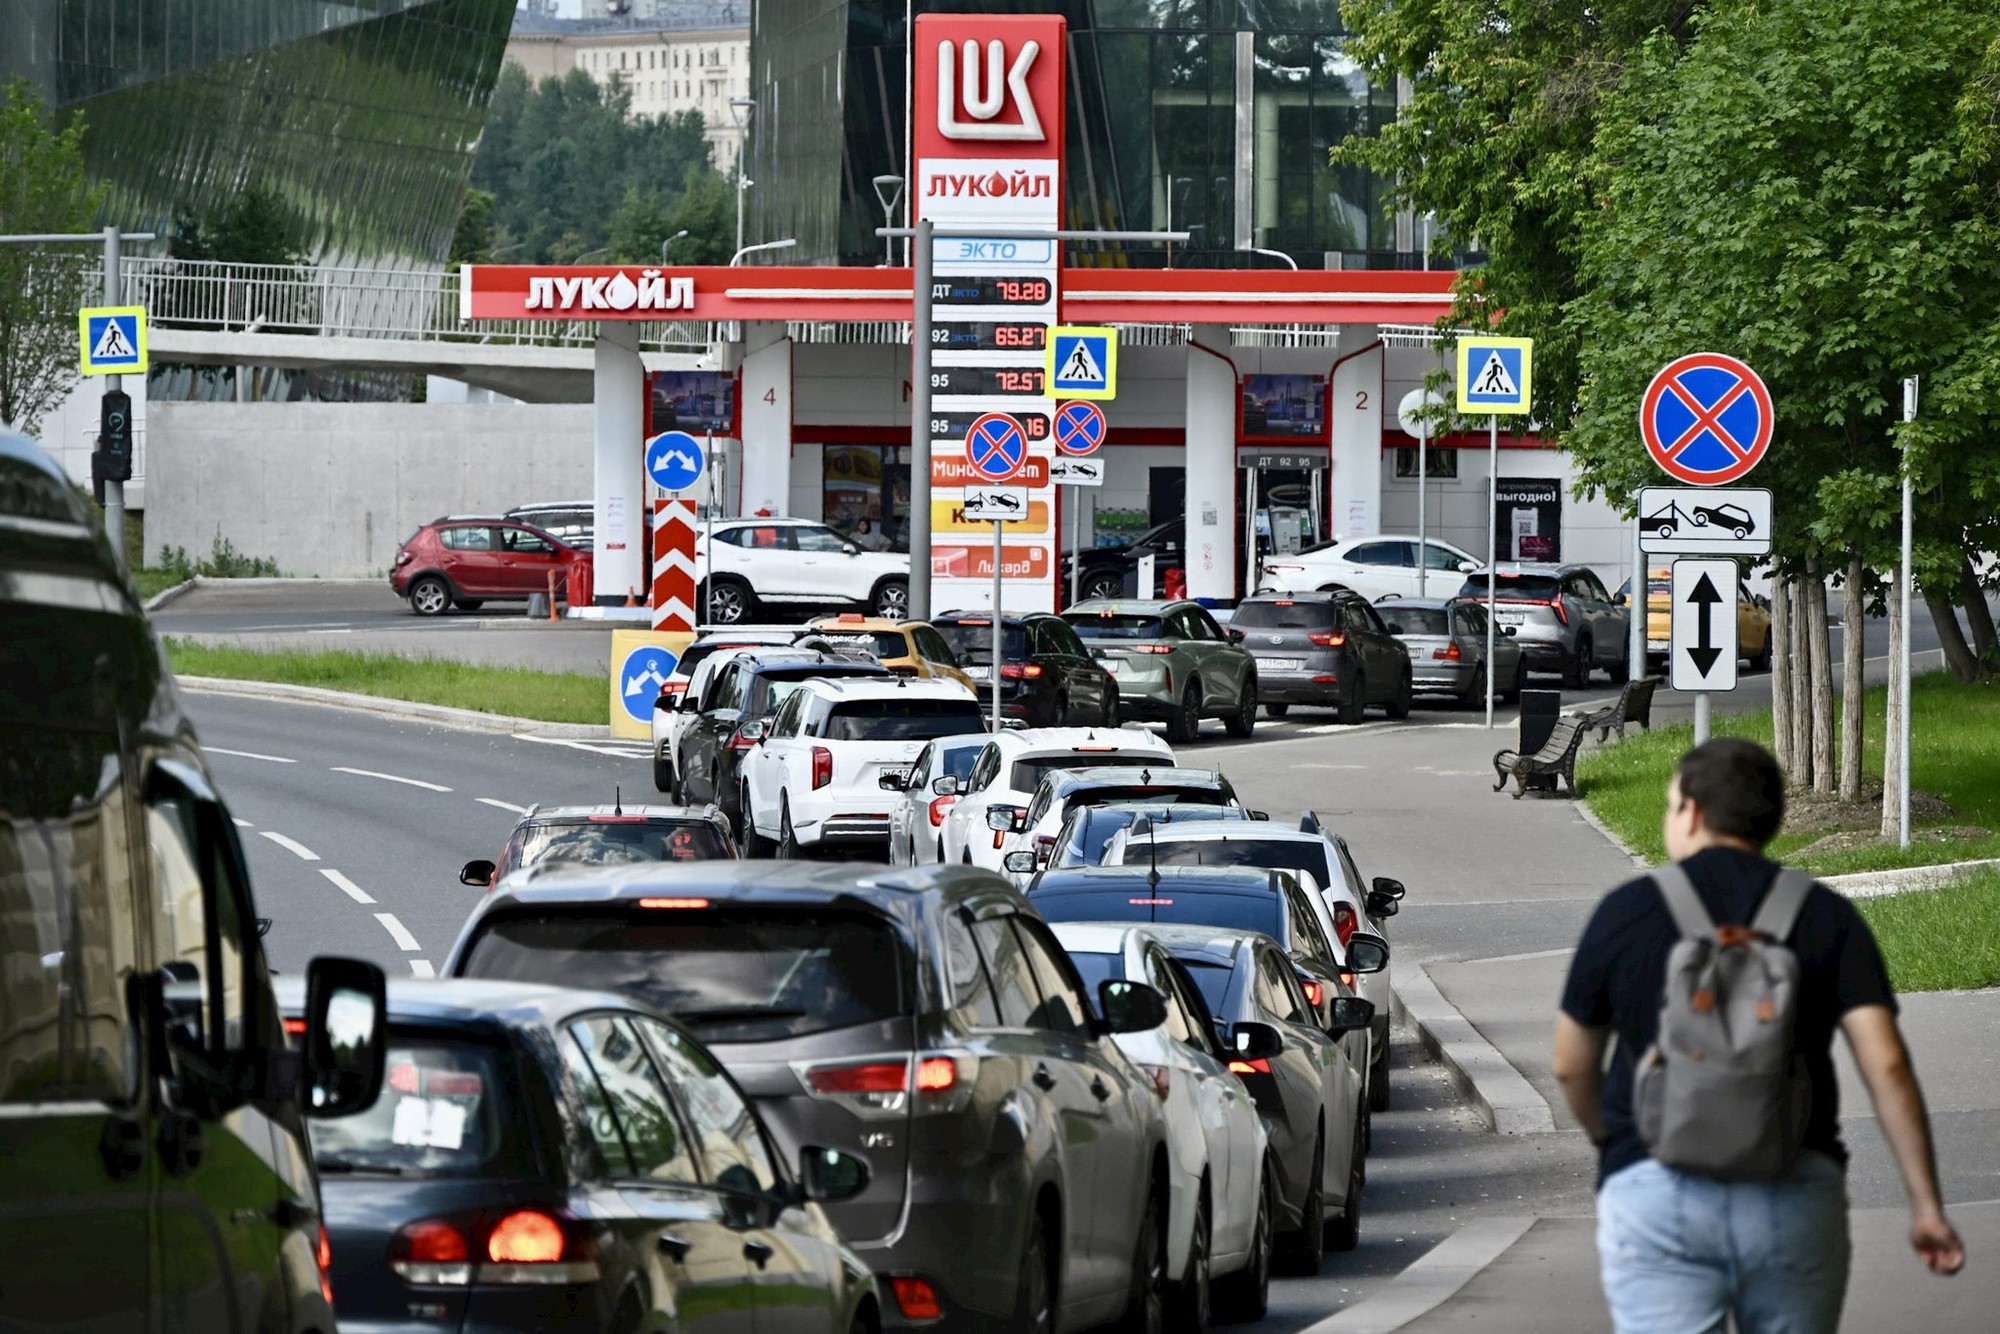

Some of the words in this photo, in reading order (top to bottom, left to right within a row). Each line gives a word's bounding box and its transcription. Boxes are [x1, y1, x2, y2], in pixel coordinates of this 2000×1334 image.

[926, 170, 1051, 198] ЛУКОЙЛ
[959, 243, 1017, 259] ЭКТО
[525, 269, 695, 310] ЛУКОЙЛ
[932, 284, 952, 299] ДТ
[996, 282, 1047, 301] 79.28
[931, 329, 950, 343] 92
[995, 327, 1045, 346] 65.27
[931, 374, 949, 388] 95
[996, 372, 1045, 391] 72.57
[763, 387, 777, 406] 4
[1355, 391, 1368, 410] 2
[931, 420, 949, 433] 95
[1259, 457, 1273, 467] ДТ
[1280, 457, 1291, 466] 92
[1299, 457, 1311, 466] 95
[1496, 490, 1557, 503] выгодно!
[978, 560, 1031, 577] Лиард
